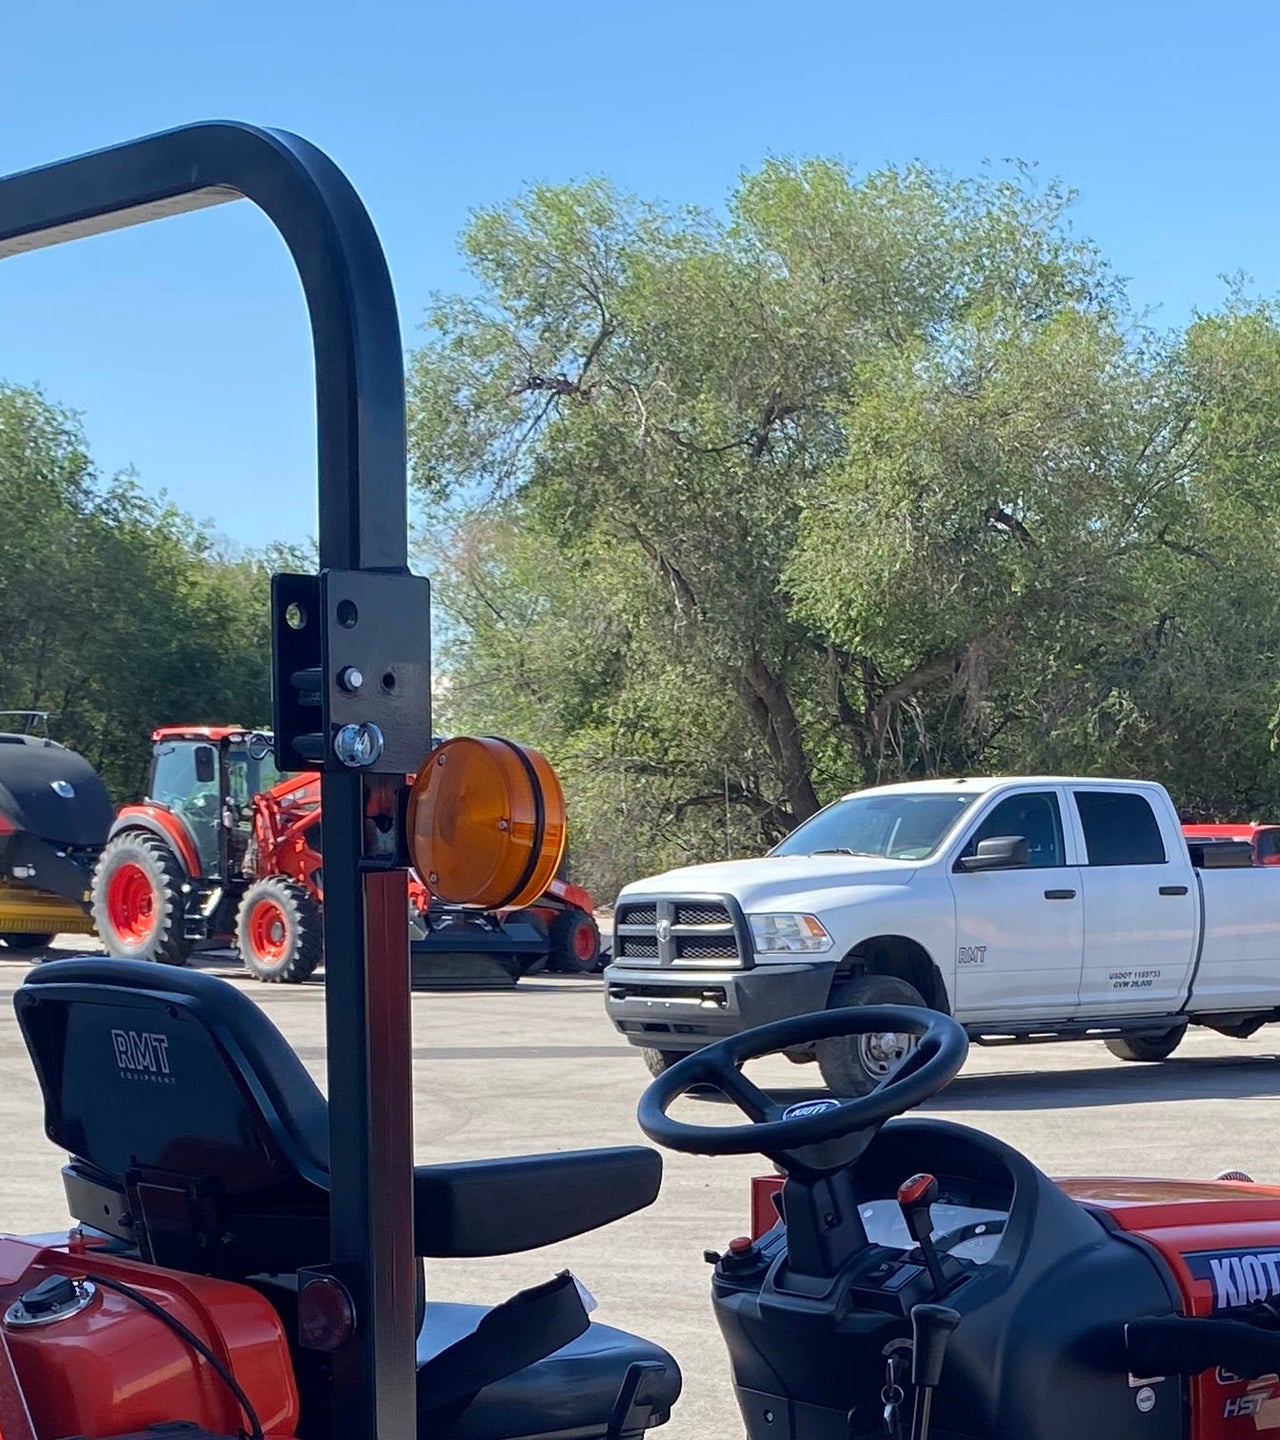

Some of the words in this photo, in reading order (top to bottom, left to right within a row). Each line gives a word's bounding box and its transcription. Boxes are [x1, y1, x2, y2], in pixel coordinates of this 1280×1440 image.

[958, 946, 986, 964] RMT
[111, 1029, 170, 1073] RMT
[1223, 1390, 1274, 1418] HST
